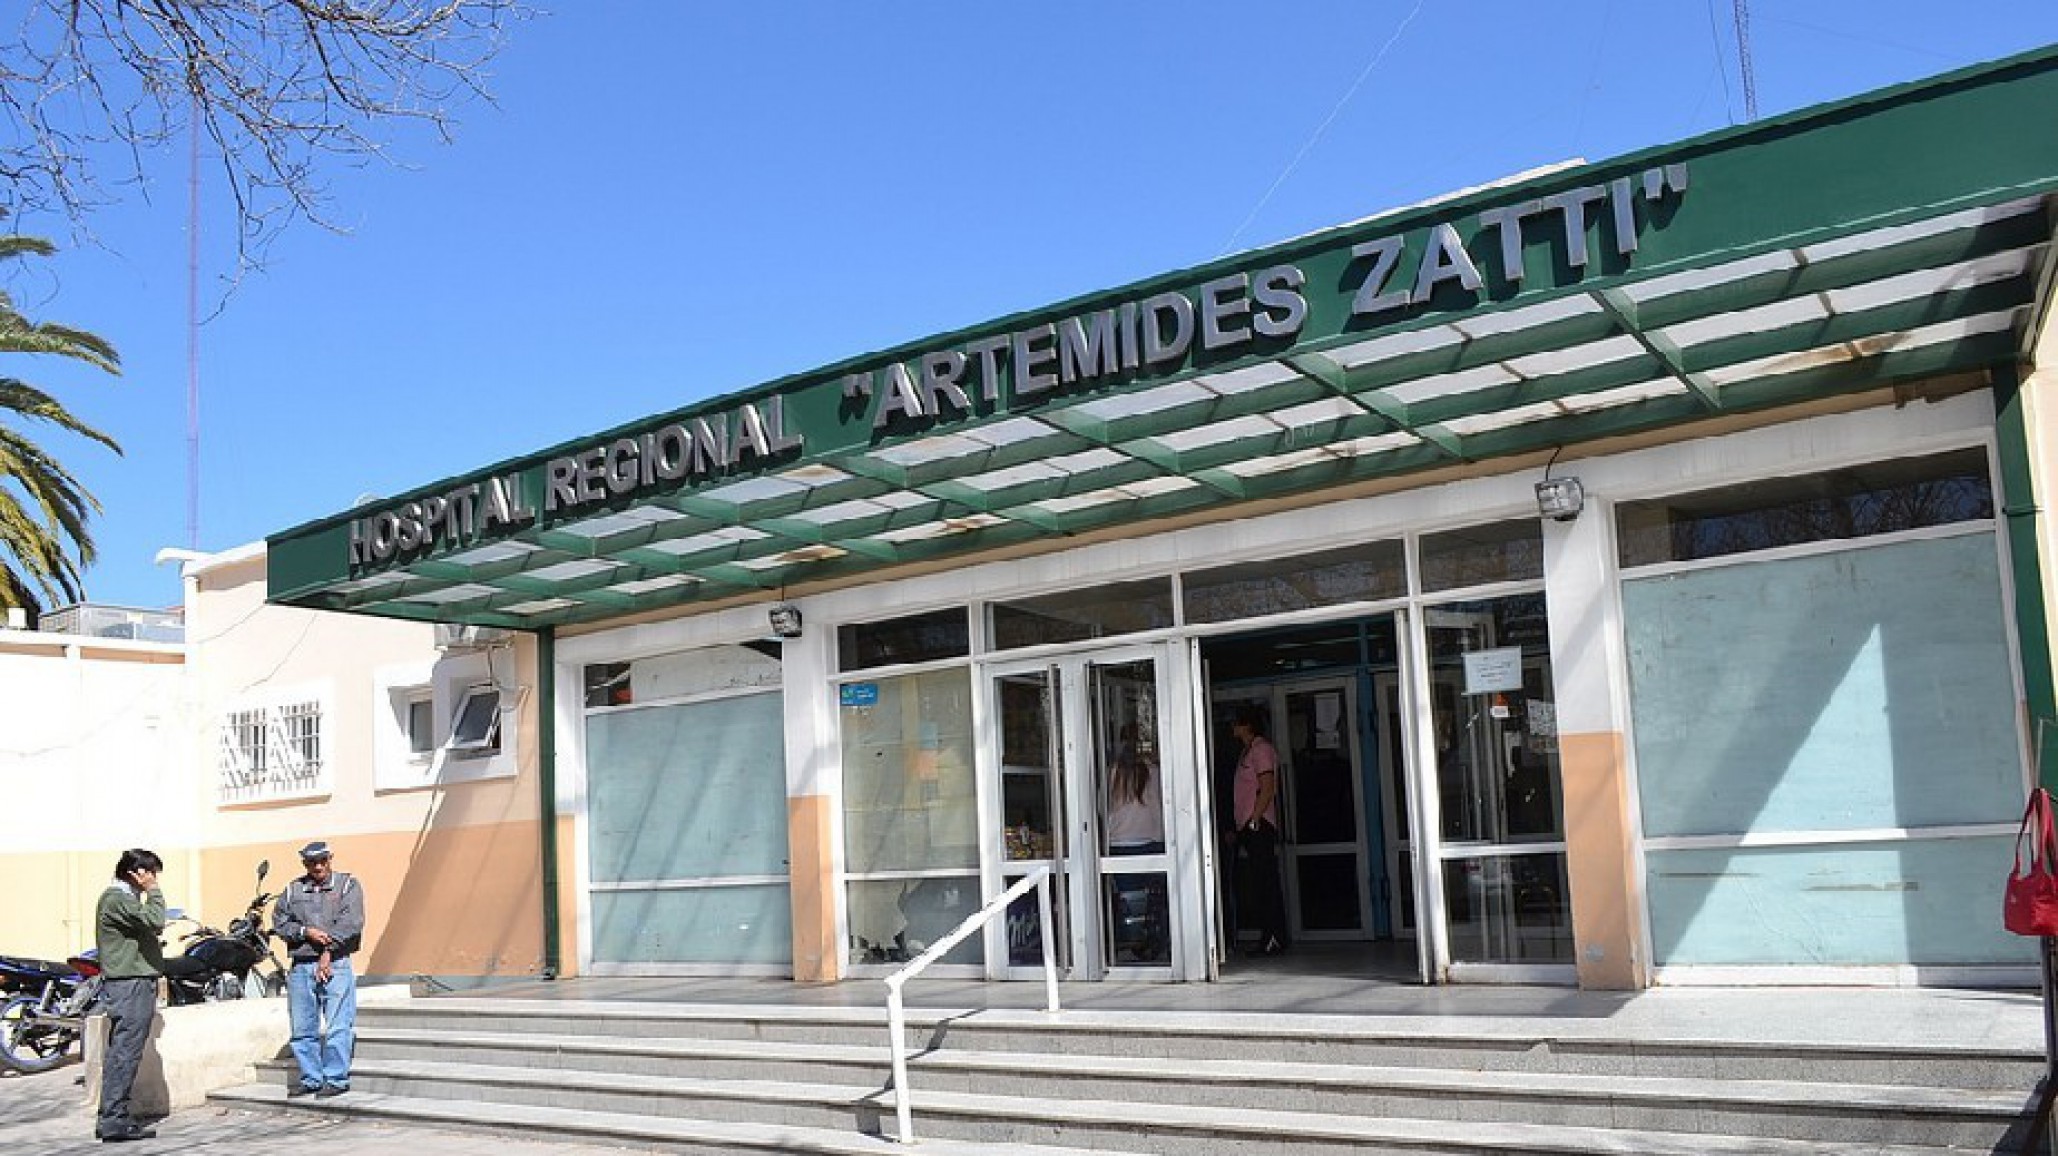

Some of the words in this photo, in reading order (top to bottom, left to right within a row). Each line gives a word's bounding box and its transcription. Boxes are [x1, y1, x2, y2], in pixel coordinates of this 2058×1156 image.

[350, 472, 535, 565] HOSPITAL
[545, 394, 803, 511] REGIONAL
[842, 264, 1308, 428] "ARTEMIDES
[1352, 162, 1687, 314] ZATTI"
